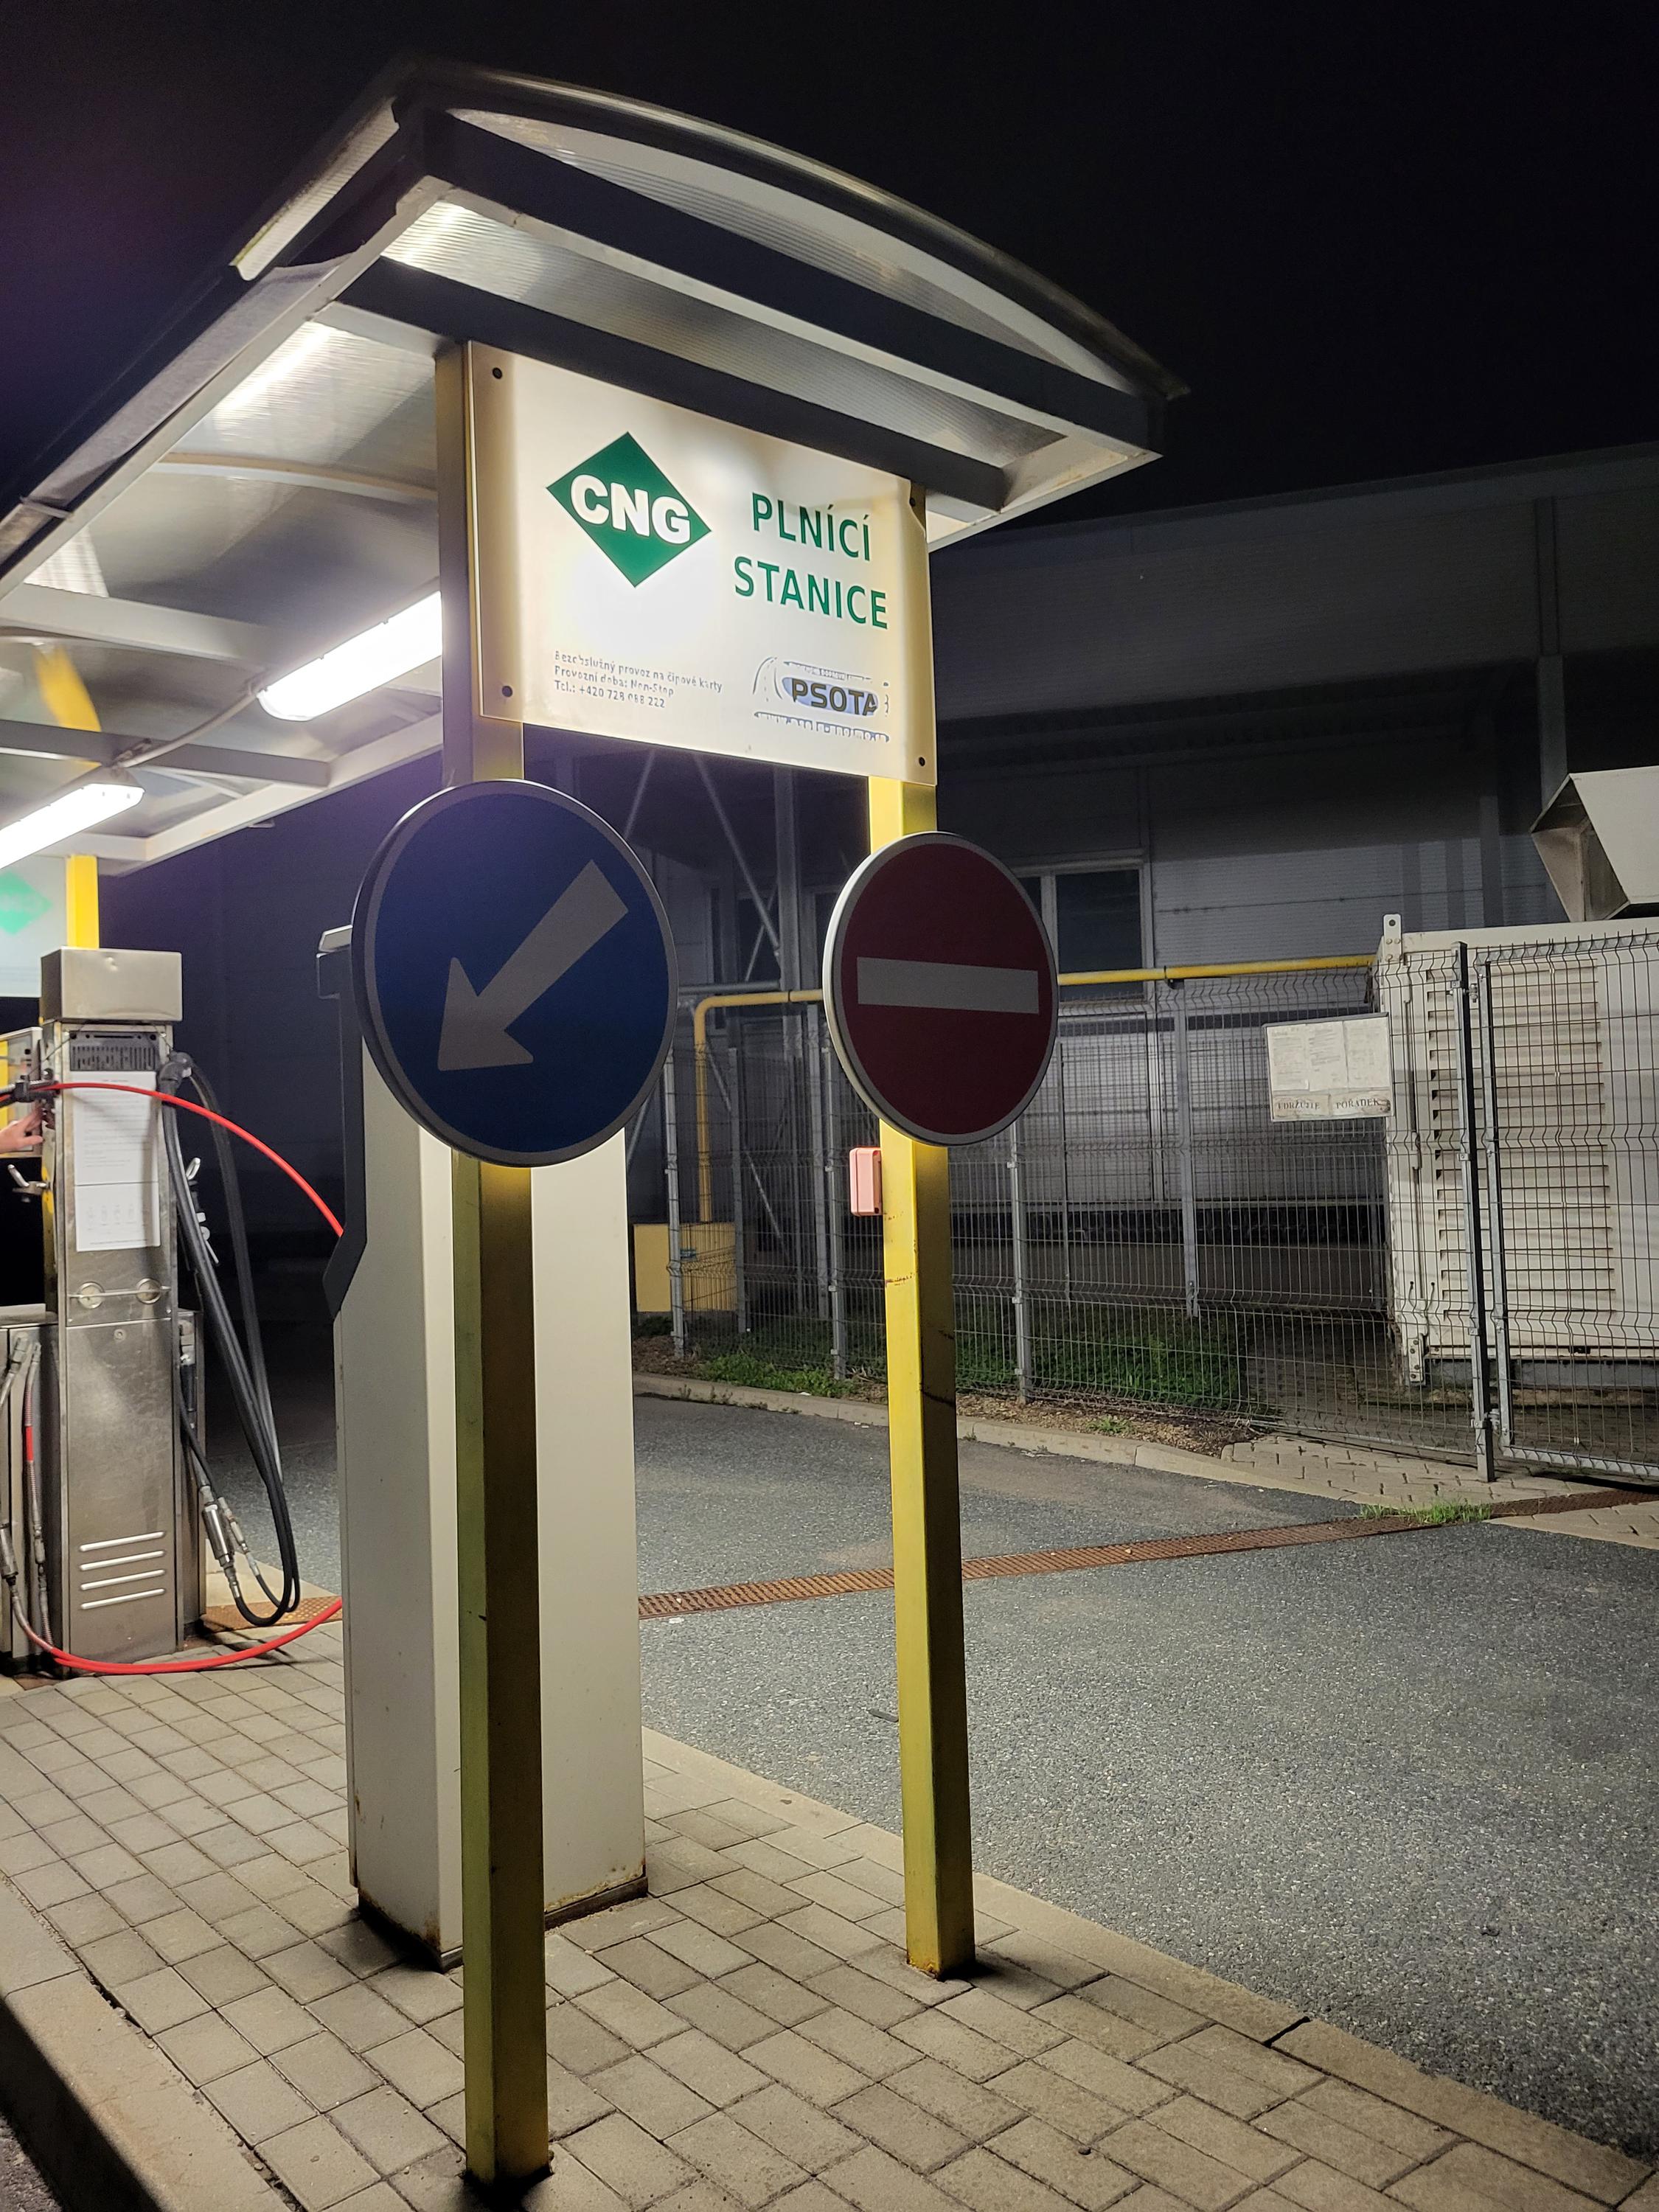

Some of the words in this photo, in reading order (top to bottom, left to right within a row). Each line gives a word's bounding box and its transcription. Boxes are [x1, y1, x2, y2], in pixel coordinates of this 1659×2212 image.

[570, 474, 692, 544] CNG
[751, 492, 871, 561] PLNÍCÍ
[734, 556, 888, 630] STANICE
[554, 665, 598, 683] Provozní
[600, 673, 627, 688] doba:
[619, 664, 650, 678] provoz
[653, 671, 664, 681] na
[554, 680, 576, 693] Tel.:
[580, 684, 604, 698] +420
[648, 696, 665, 709] 222
[792, 678, 877, 716] PSOTA
